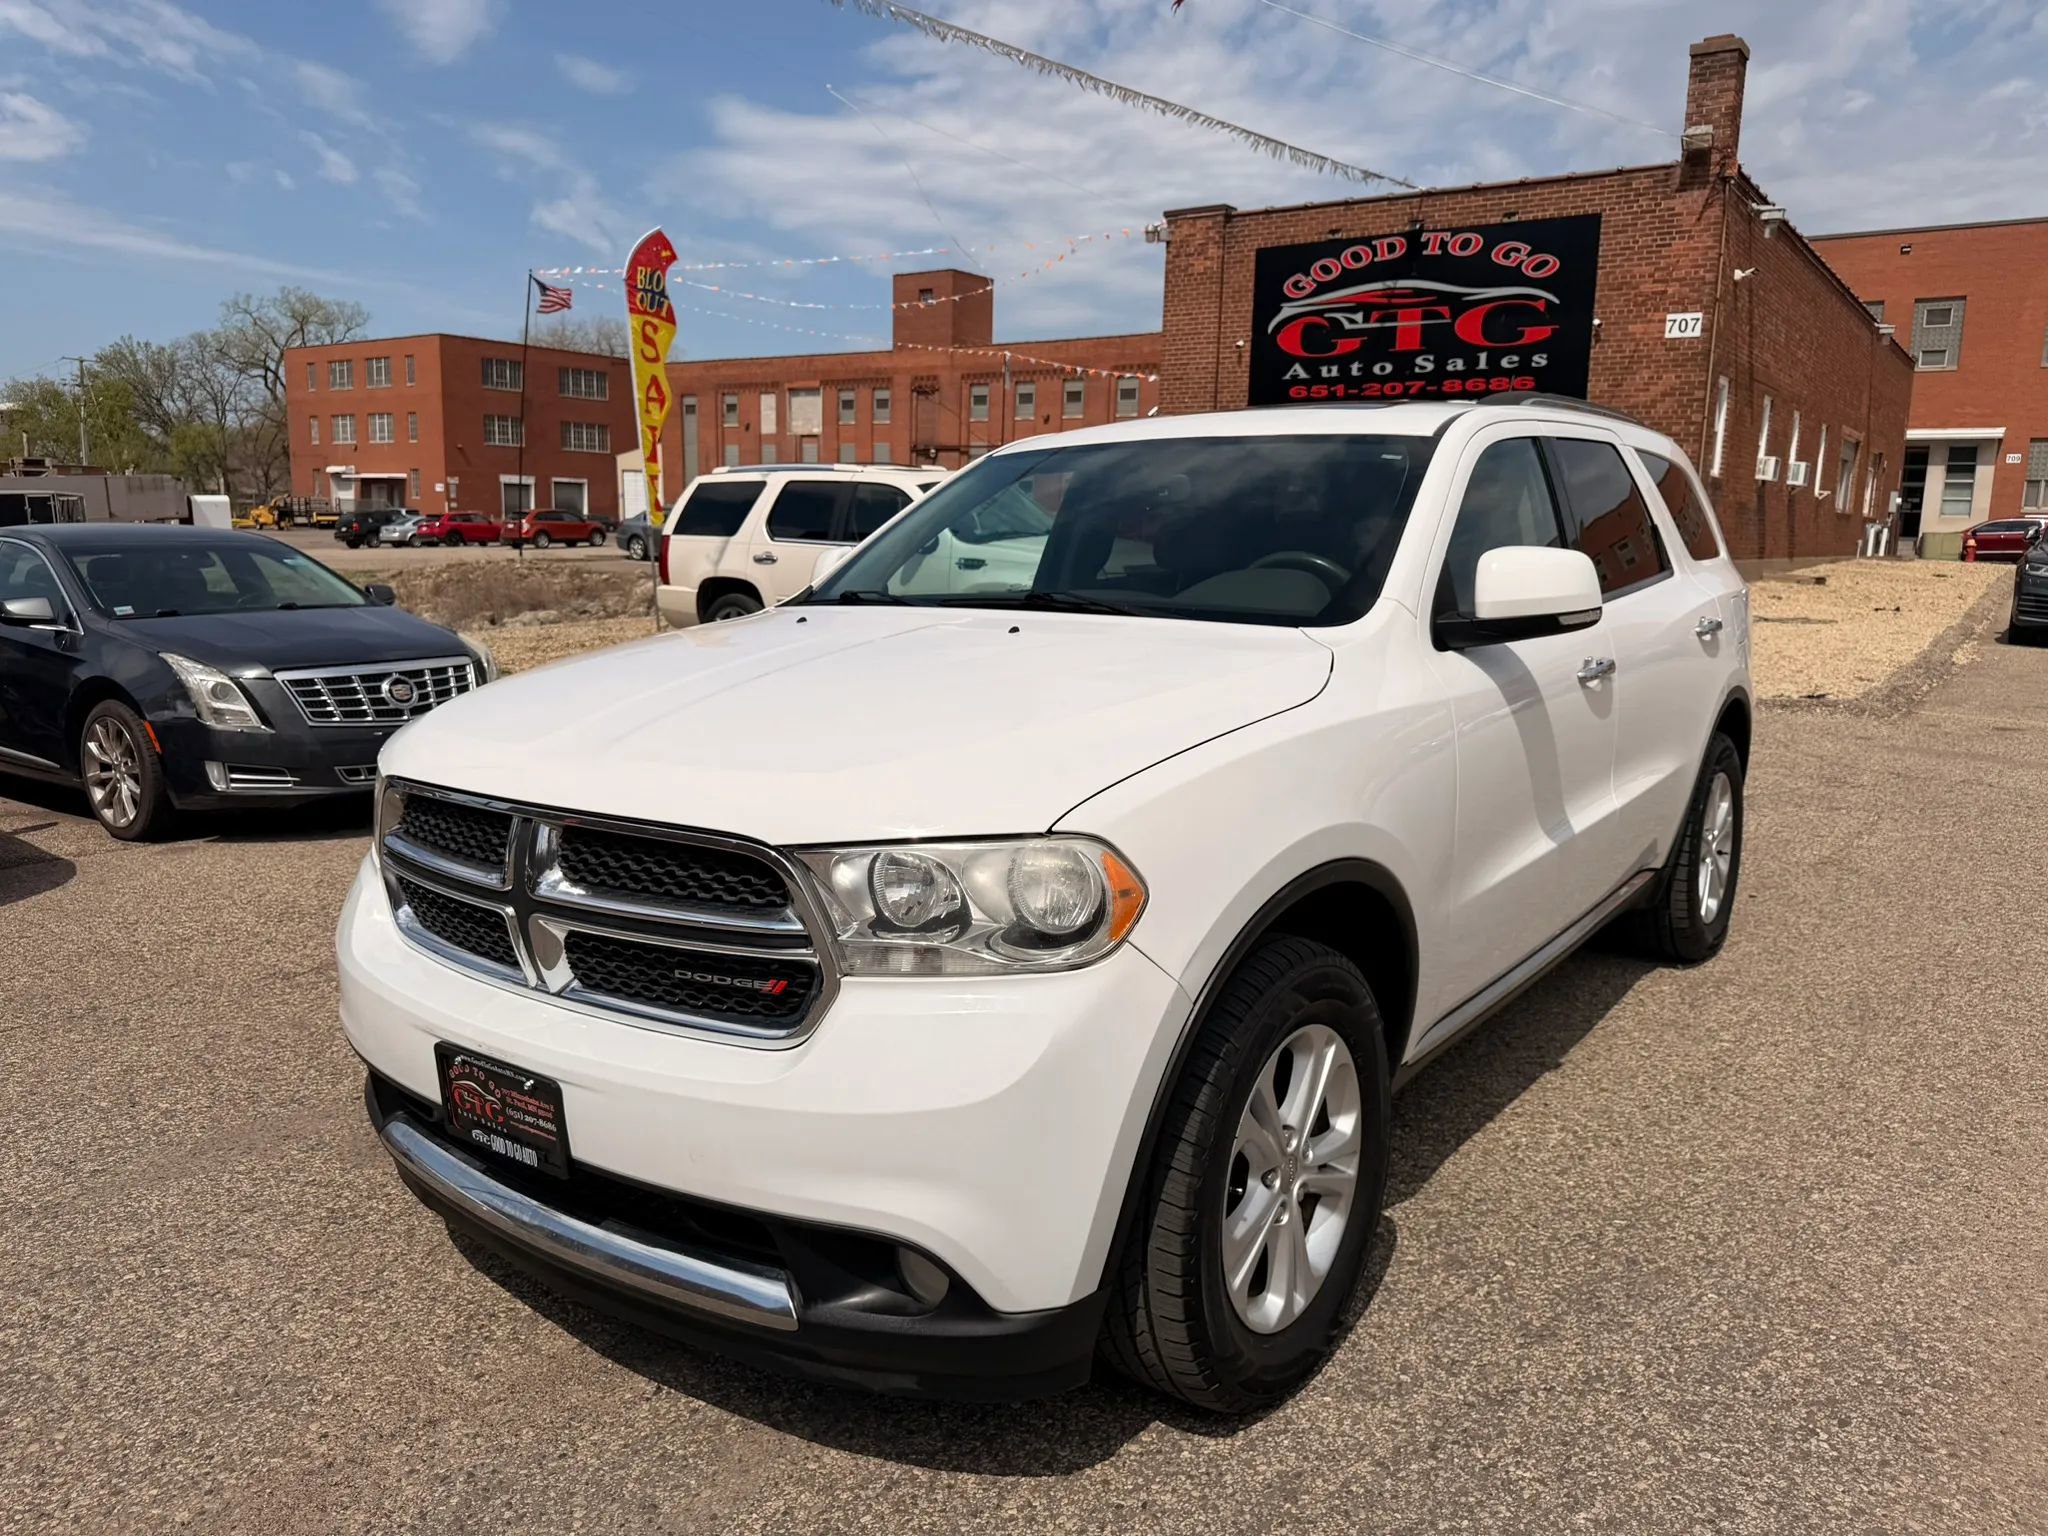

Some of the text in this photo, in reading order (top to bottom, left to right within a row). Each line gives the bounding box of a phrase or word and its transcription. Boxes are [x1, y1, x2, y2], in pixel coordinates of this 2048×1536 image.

[1283, 232, 1560, 298] GOOD TO GO
[636, 266, 665, 292] BLO
[636, 291, 670, 318] OUT
[1276, 299, 1560, 358] GTG
[1668, 317, 1701, 333] 707
[1281, 352, 1549, 381] Auto Sales
[1288, 376, 1537, 399] 651-207-8686
[674, 969, 773, 990] DODGE
[505, 1139, 514, 1158] TO
[522, 1147, 538, 1167] AUTO
